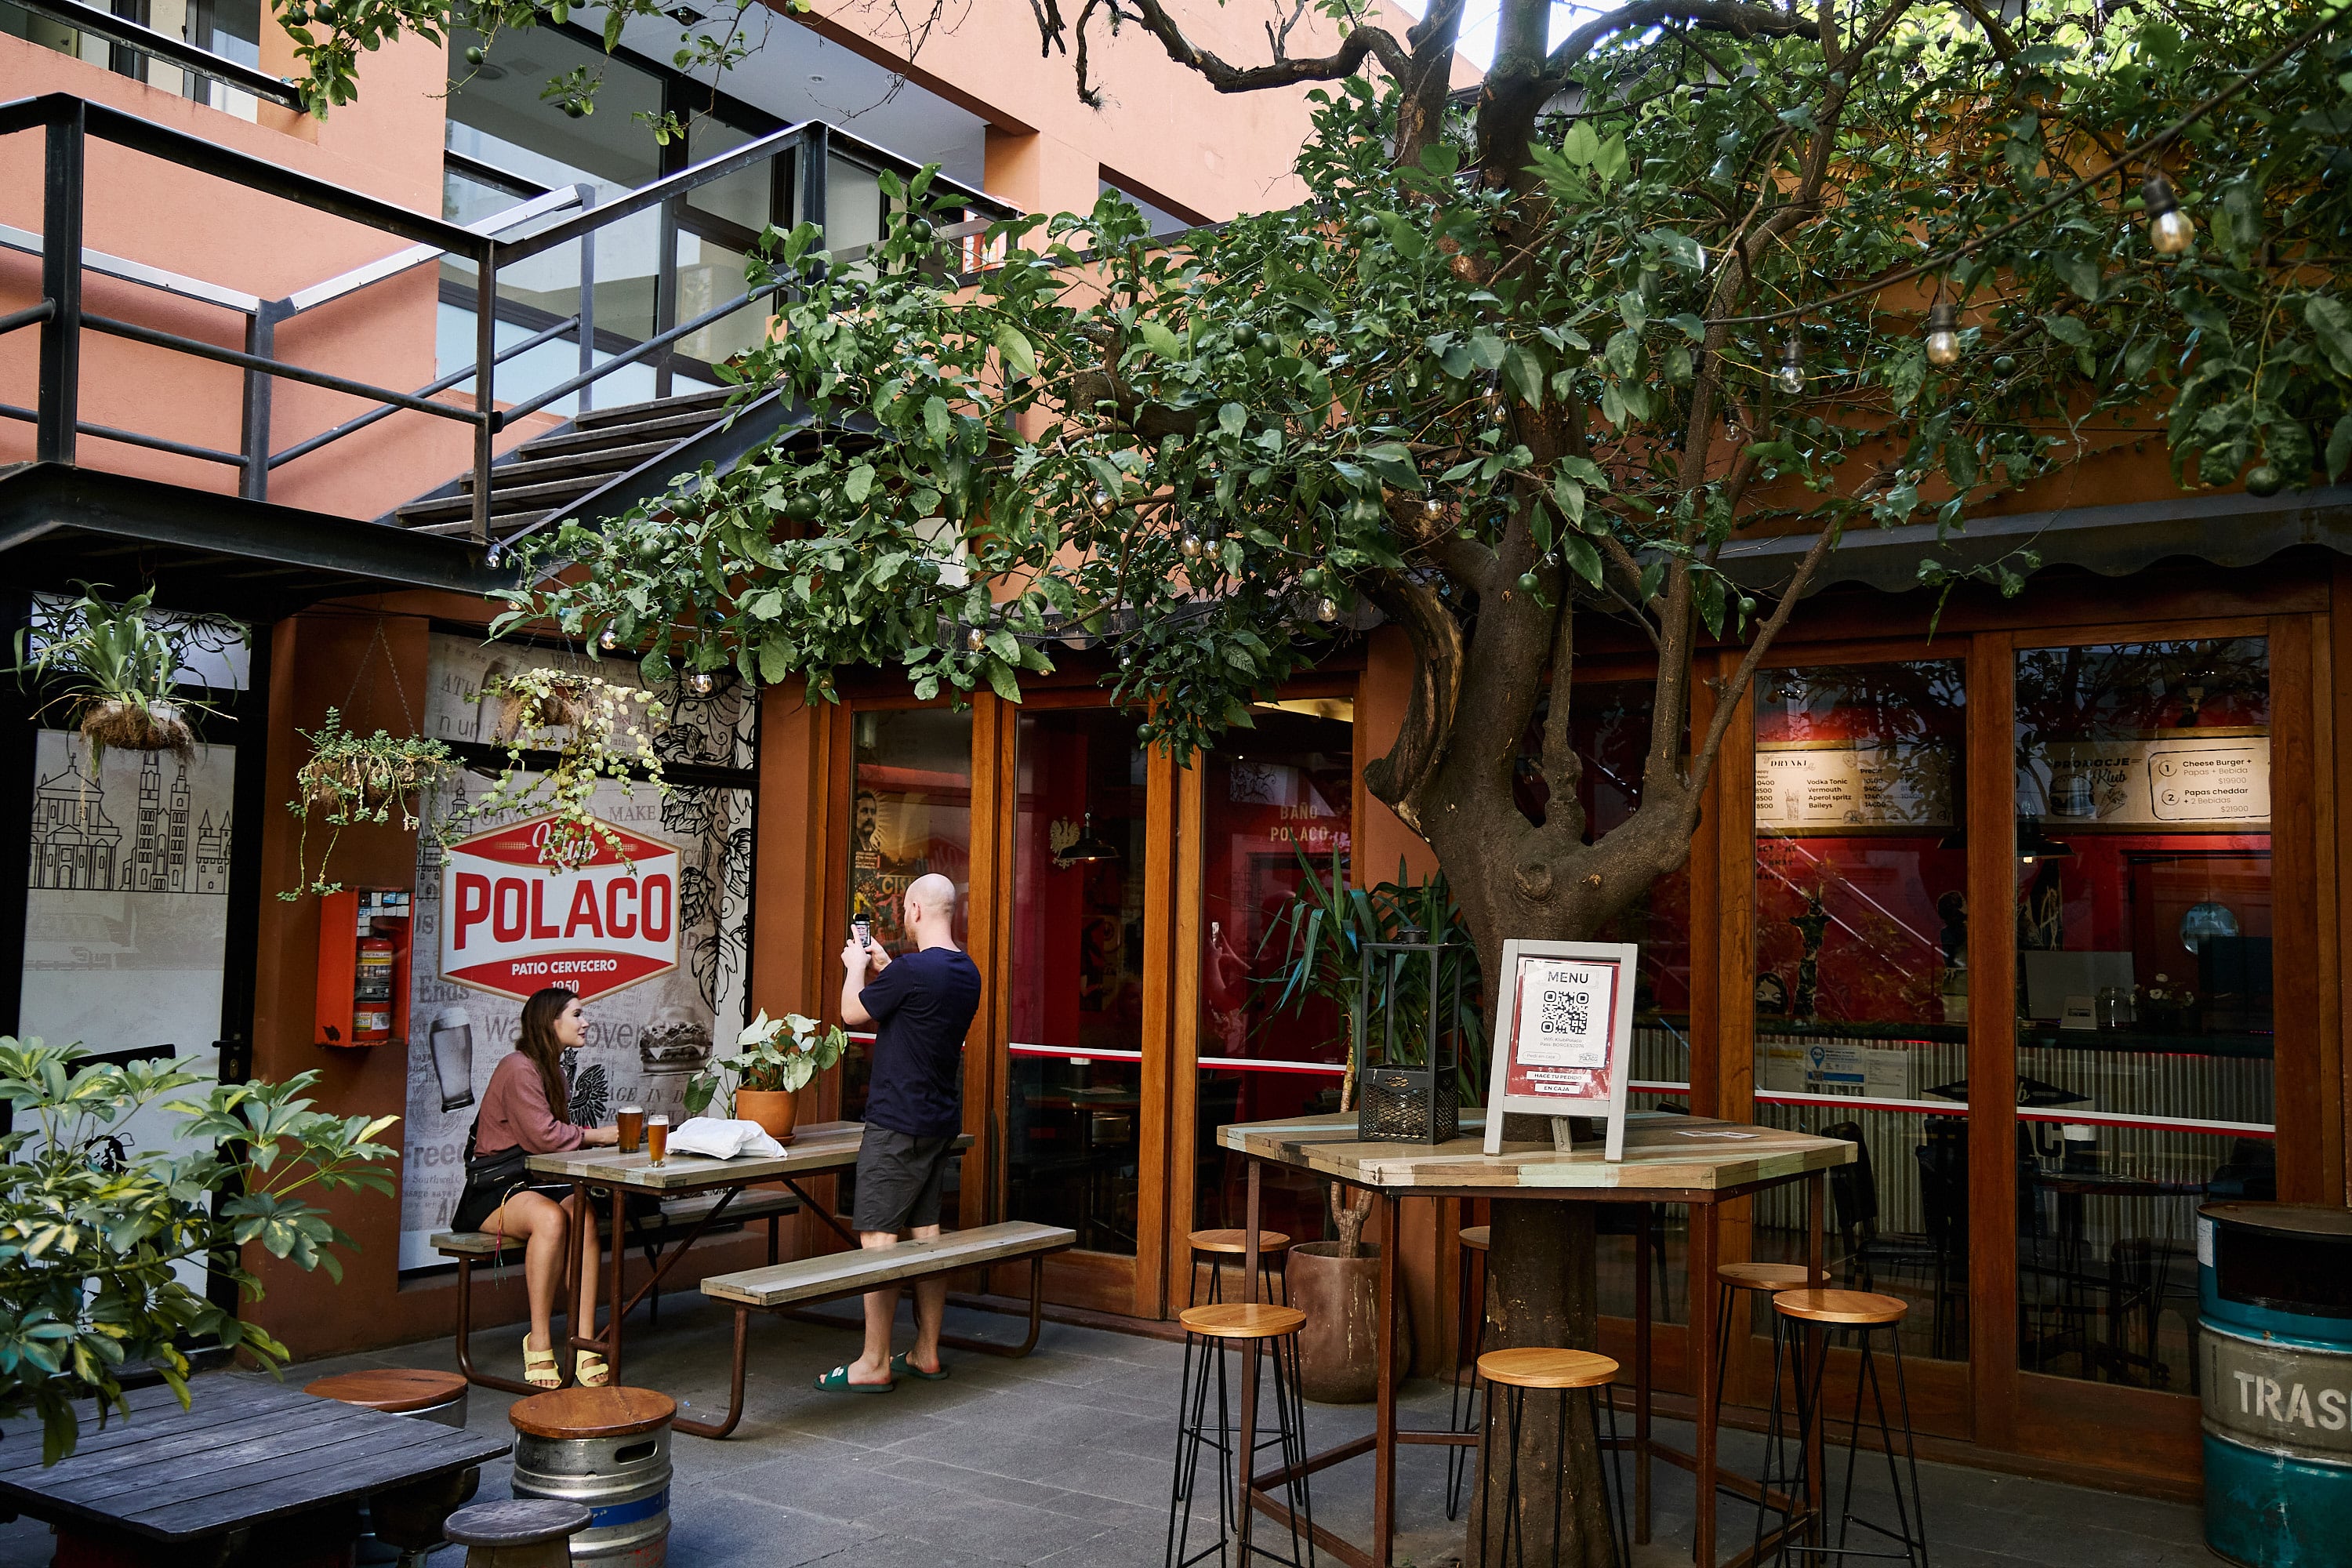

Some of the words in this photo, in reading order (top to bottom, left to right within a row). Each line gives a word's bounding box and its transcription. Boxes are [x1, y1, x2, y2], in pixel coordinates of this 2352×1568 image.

[2053, 757, 2130, 768] PROMOCJE
[2092, 768, 2127, 787] Klub
[608, 805, 656, 822] MAKE
[1279, 801, 1318, 820] BAÑO
[453, 872, 672, 951] POLACO
[511, 961, 548, 977] PATIO
[550, 958, 618, 975] CERVECERO
[1548, 971, 1588, 984] MENU
[2234, 1370, 2352, 1431] TRAS
